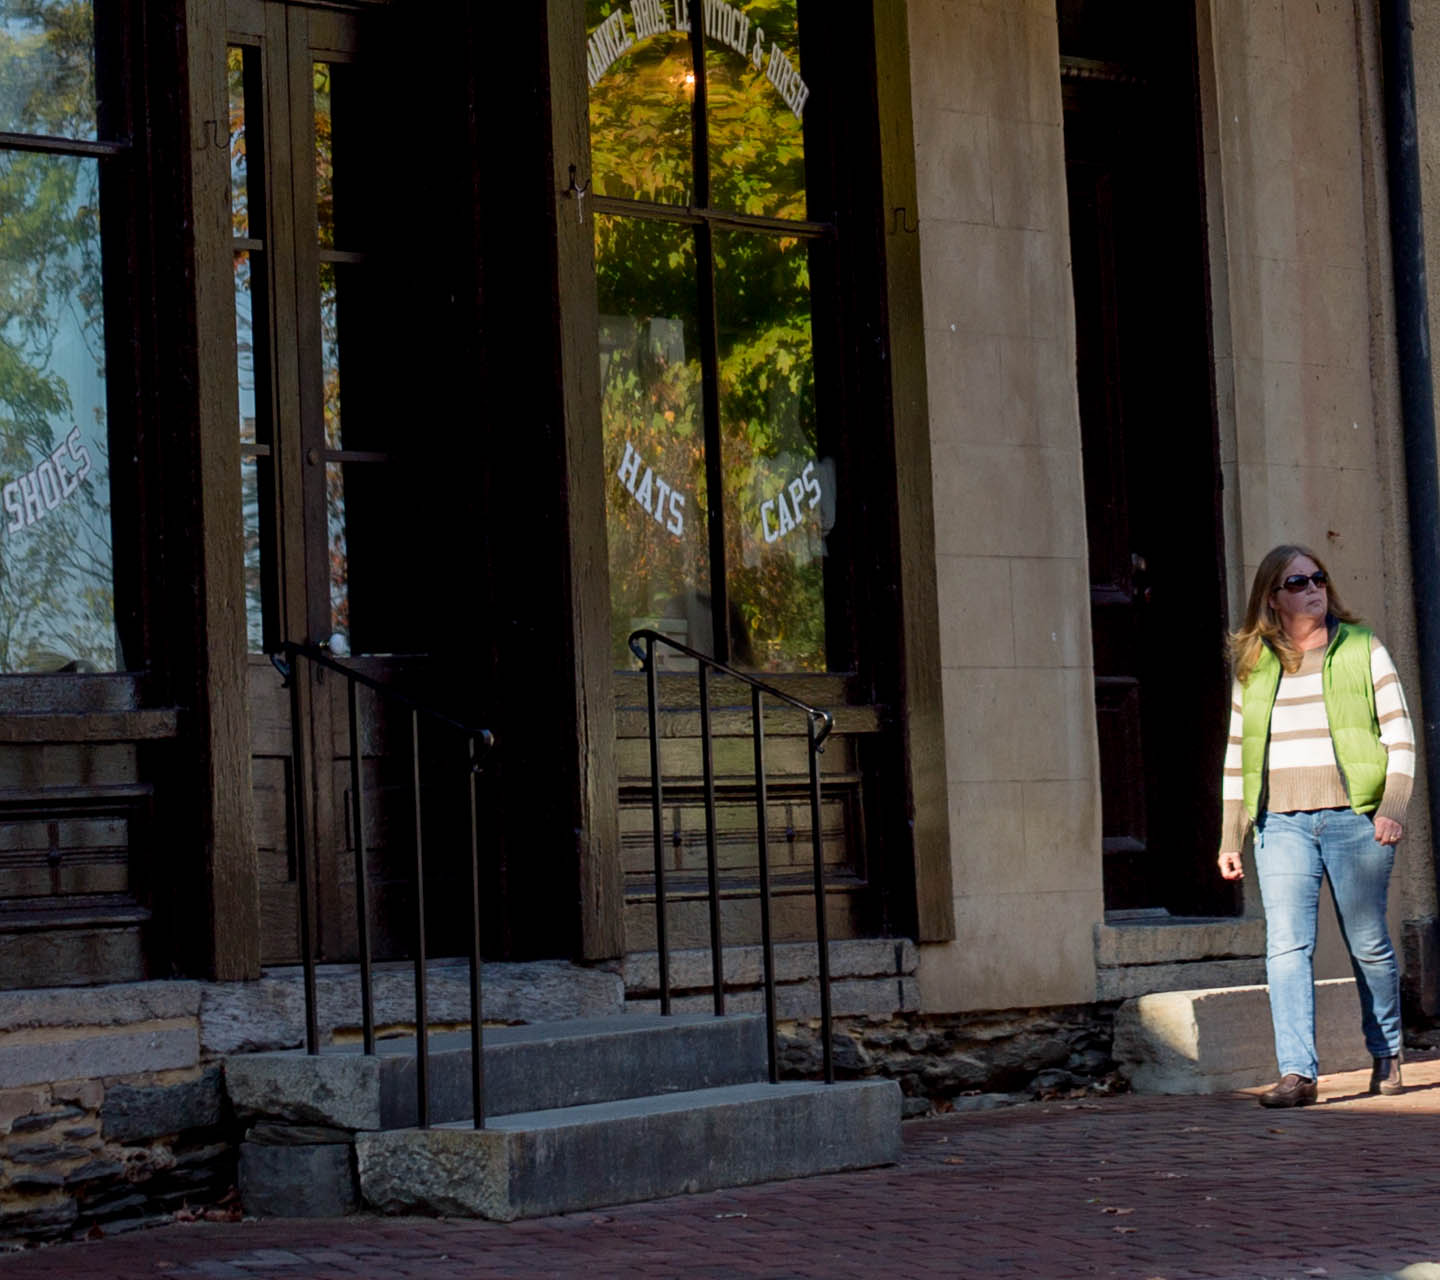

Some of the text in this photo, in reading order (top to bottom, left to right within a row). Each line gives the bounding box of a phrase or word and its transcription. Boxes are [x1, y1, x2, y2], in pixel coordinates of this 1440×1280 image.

[752, 27, 765, 71] &
[766, 41, 809, 121] HIRSH
[2, 425, 92, 534] SHOES
[616, 439, 822, 544] HATS CAPS
